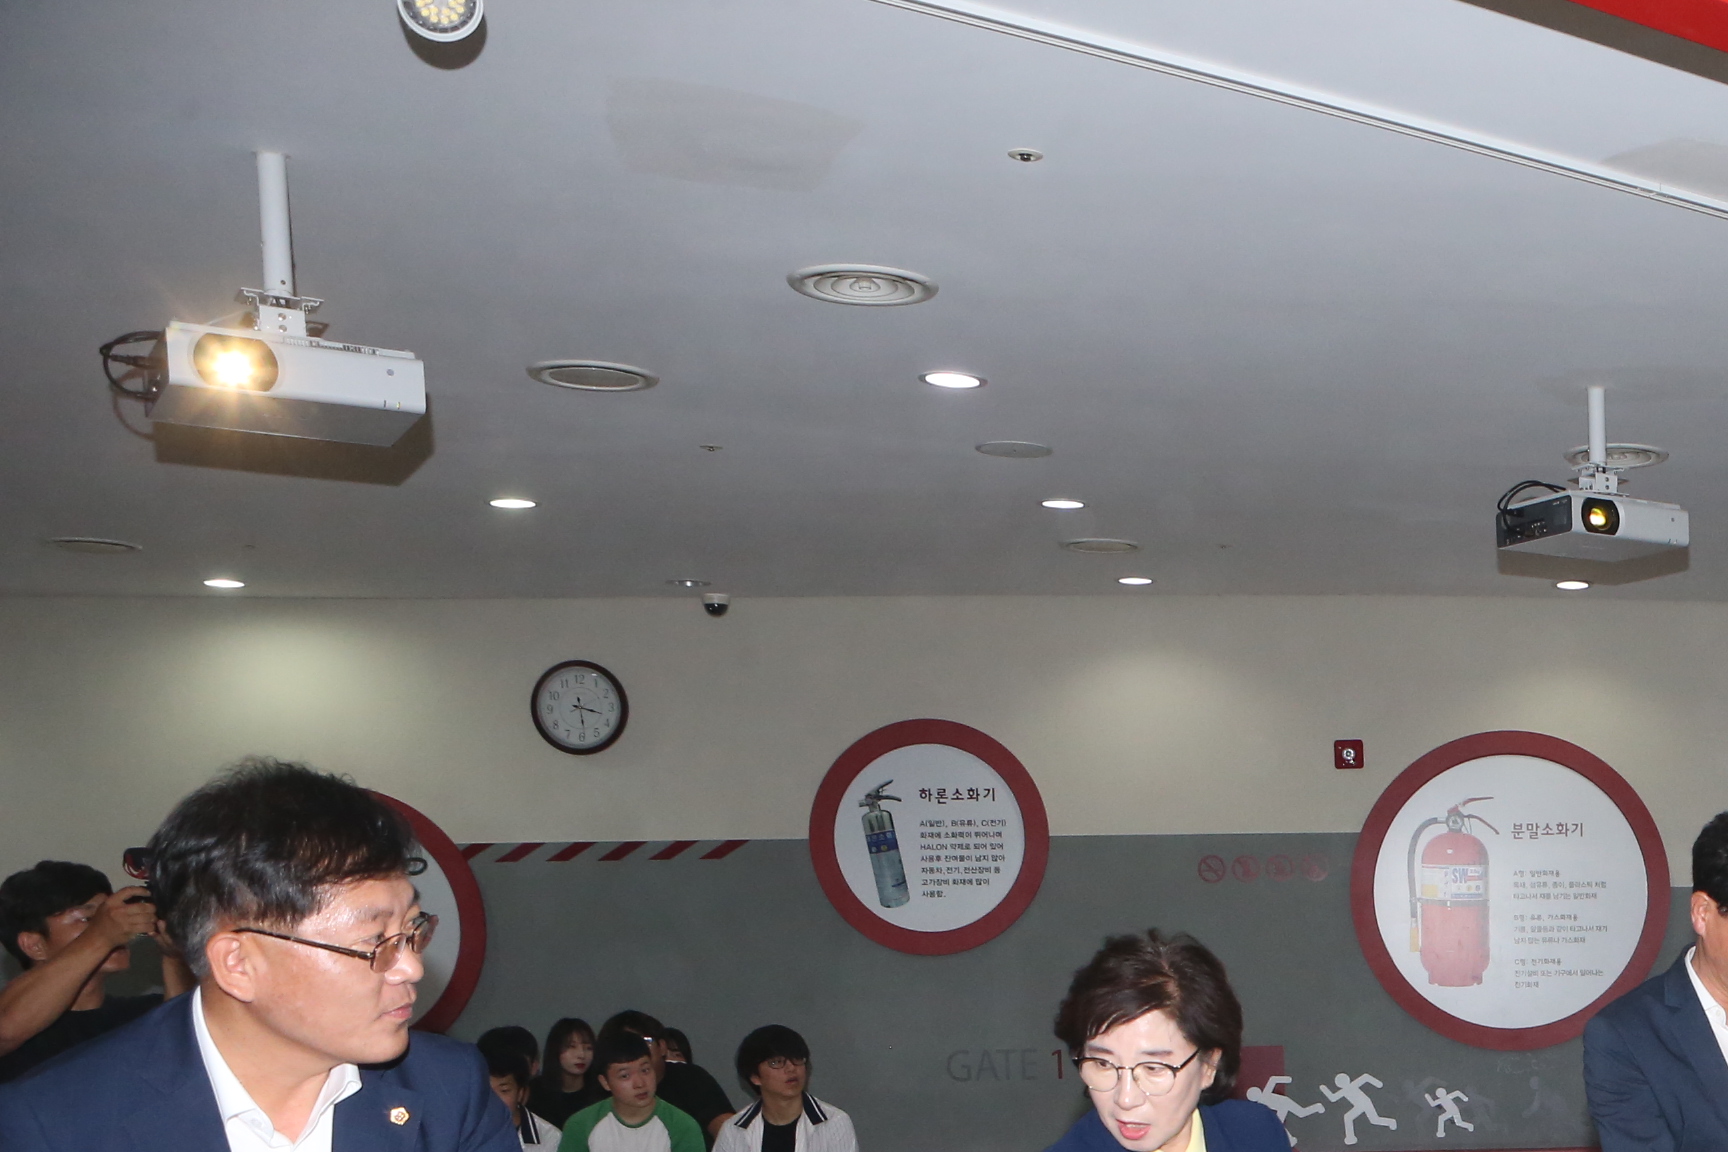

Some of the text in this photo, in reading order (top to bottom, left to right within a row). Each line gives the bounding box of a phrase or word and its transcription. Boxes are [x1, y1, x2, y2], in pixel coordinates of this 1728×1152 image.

[560, 679, 569, 688] 11
[575, 674, 585, 684] 12
[548, 690, 560, 701] 10
[602, 688, 609, 699] 2
[546, 704, 554, 714] 9
[608, 702, 614, 712] 3
[553, 720, 559, 729] 8
[604, 718, 610, 728] 4
[564, 729, 570, 739] 7
[579, 732, 585, 742] 6
[594, 727, 600, 738] 5
[918, 787, 996, 804] 하론소화기
[1511, 822, 1584, 840] 분말소화기
[946, 1049, 1063, 1082] GATE 1
